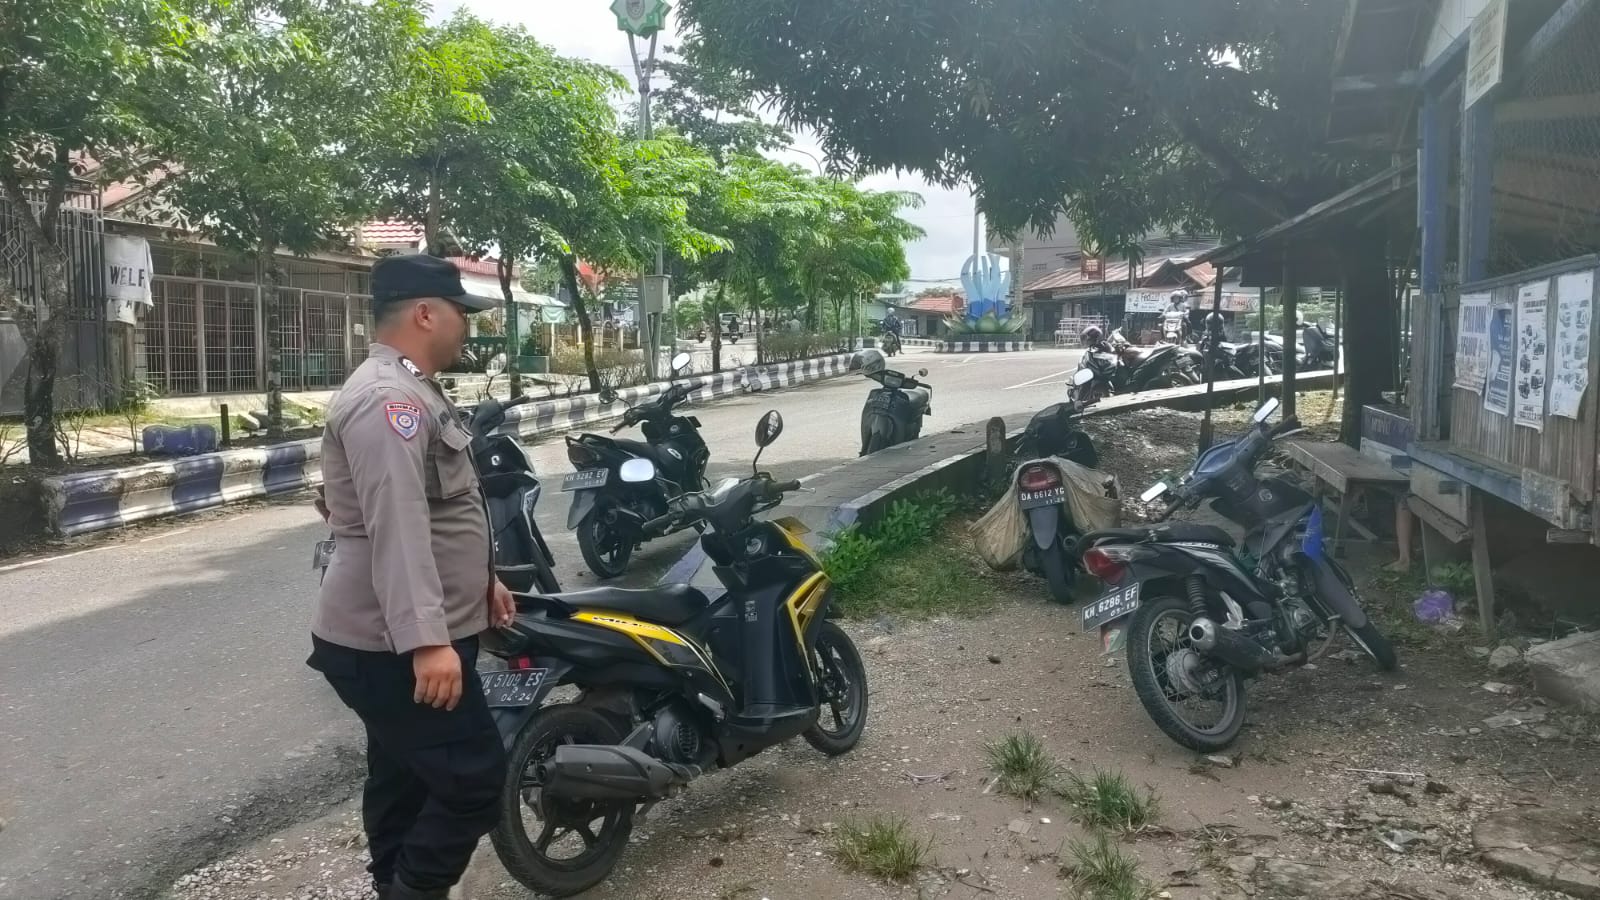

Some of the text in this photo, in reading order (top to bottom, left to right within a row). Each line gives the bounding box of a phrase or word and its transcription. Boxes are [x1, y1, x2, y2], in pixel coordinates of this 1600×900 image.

[1021, 493, 1032, 501] DA
[1084, 586, 1137, 620] KH 6286 EF
[493, 673, 522, 688] 5109
[525, 672, 543, 687] ES
